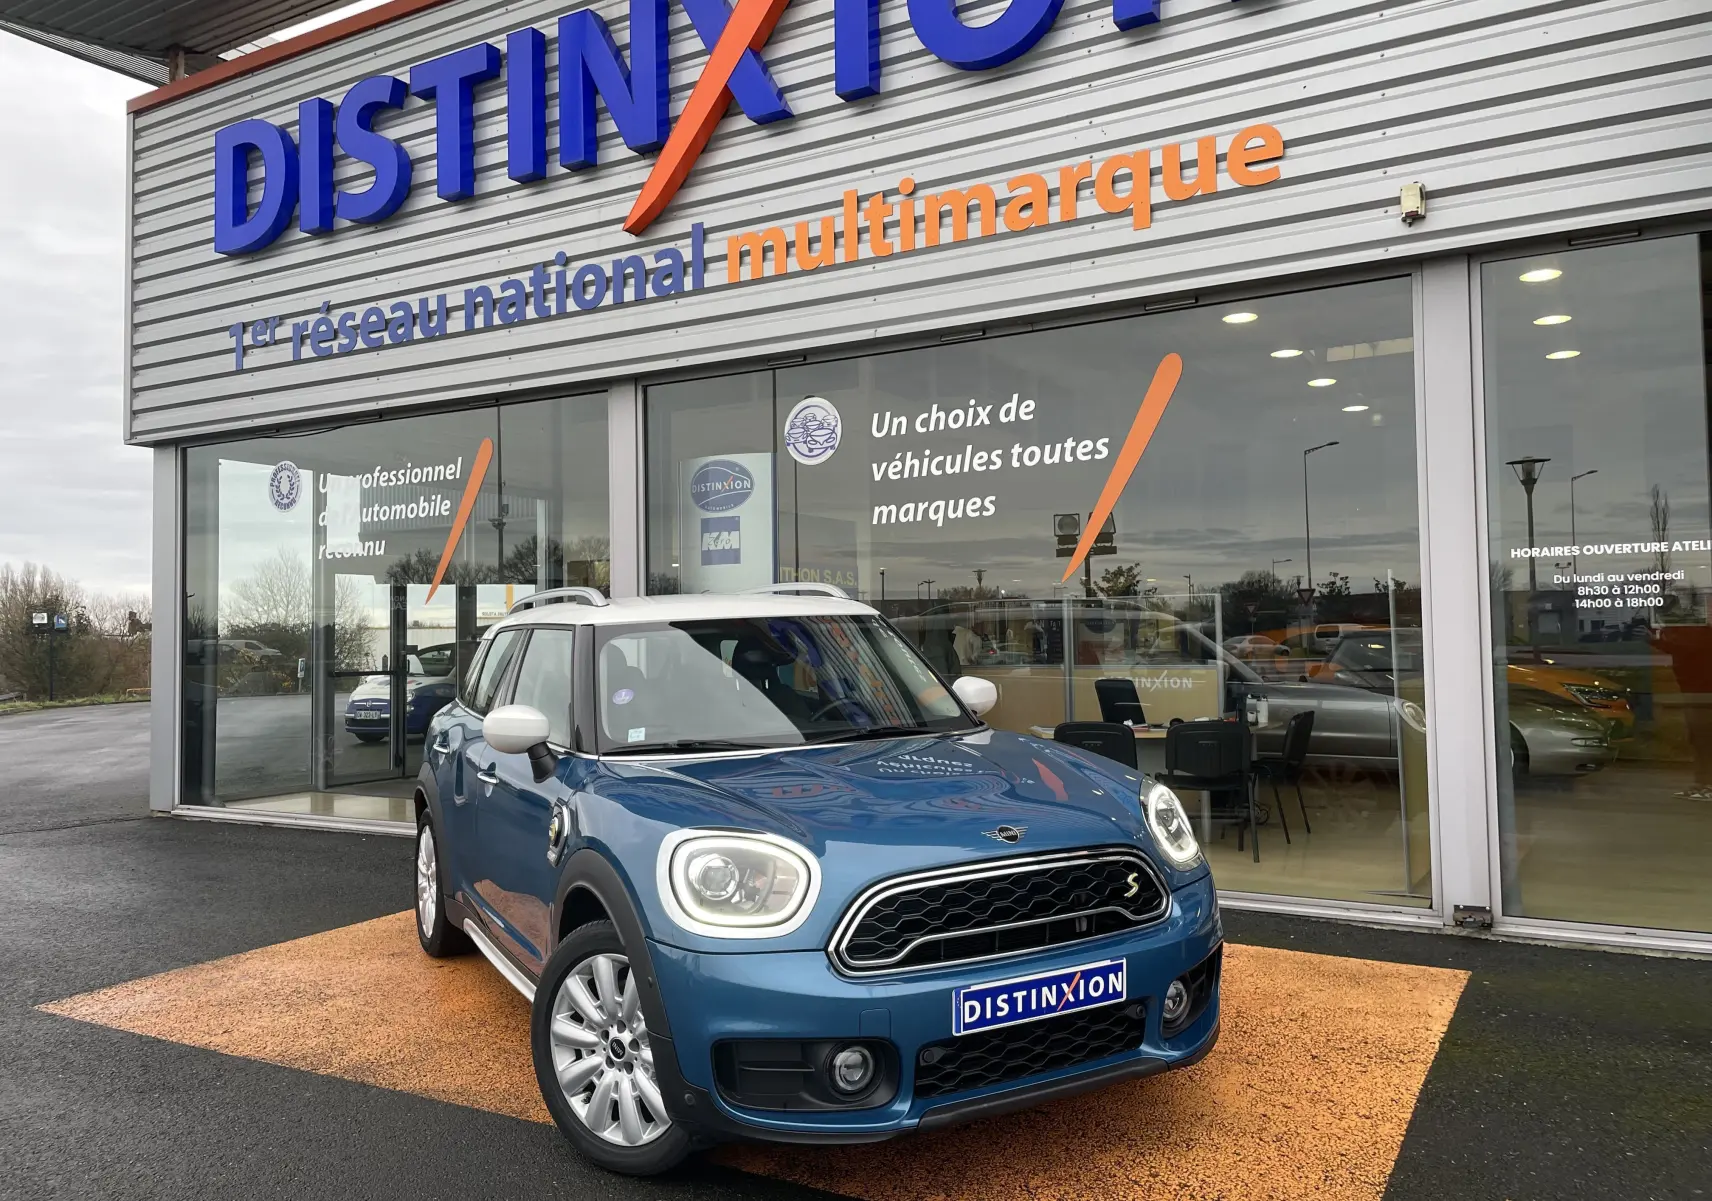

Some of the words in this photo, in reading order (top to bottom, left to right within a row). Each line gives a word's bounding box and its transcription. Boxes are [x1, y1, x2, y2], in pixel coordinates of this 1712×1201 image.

[229, 318, 281, 371] 1er
[292, 300, 447, 362] réseau
[464, 222, 706, 333] national
[727, 124, 1284, 284] multimarque
[871, 411, 908, 439] Un
[915, 398, 993, 433] choix
[999, 393, 1036, 423] de
[871, 444, 1003, 483] véhicules
[1010, 436, 1111, 468] toutes
[691, 475, 752, 494] DISTINXION
[872, 495, 997, 528] marques
[1510, 545, 1581, 559] HORAIRES
[1582, 541, 1669, 556] OUVERTURE
[1553, 574, 1571, 584] Du
[1573, 572, 1605, 583] lundi
[1607, 573, 1624, 583] au
[1626, 569, 1685, 582] vendredi
[1574, 598, 1612, 609] 14h00
[1614, 597, 1624, 608] à
[1626, 596, 1664, 607] 18h00
[1577, 585, 1609, 596] 8h30
[1611, 584, 1622, 595] à
[1623, 584, 1661, 595] 12h00
[963, 971, 1124, 1025] DISTINXION
